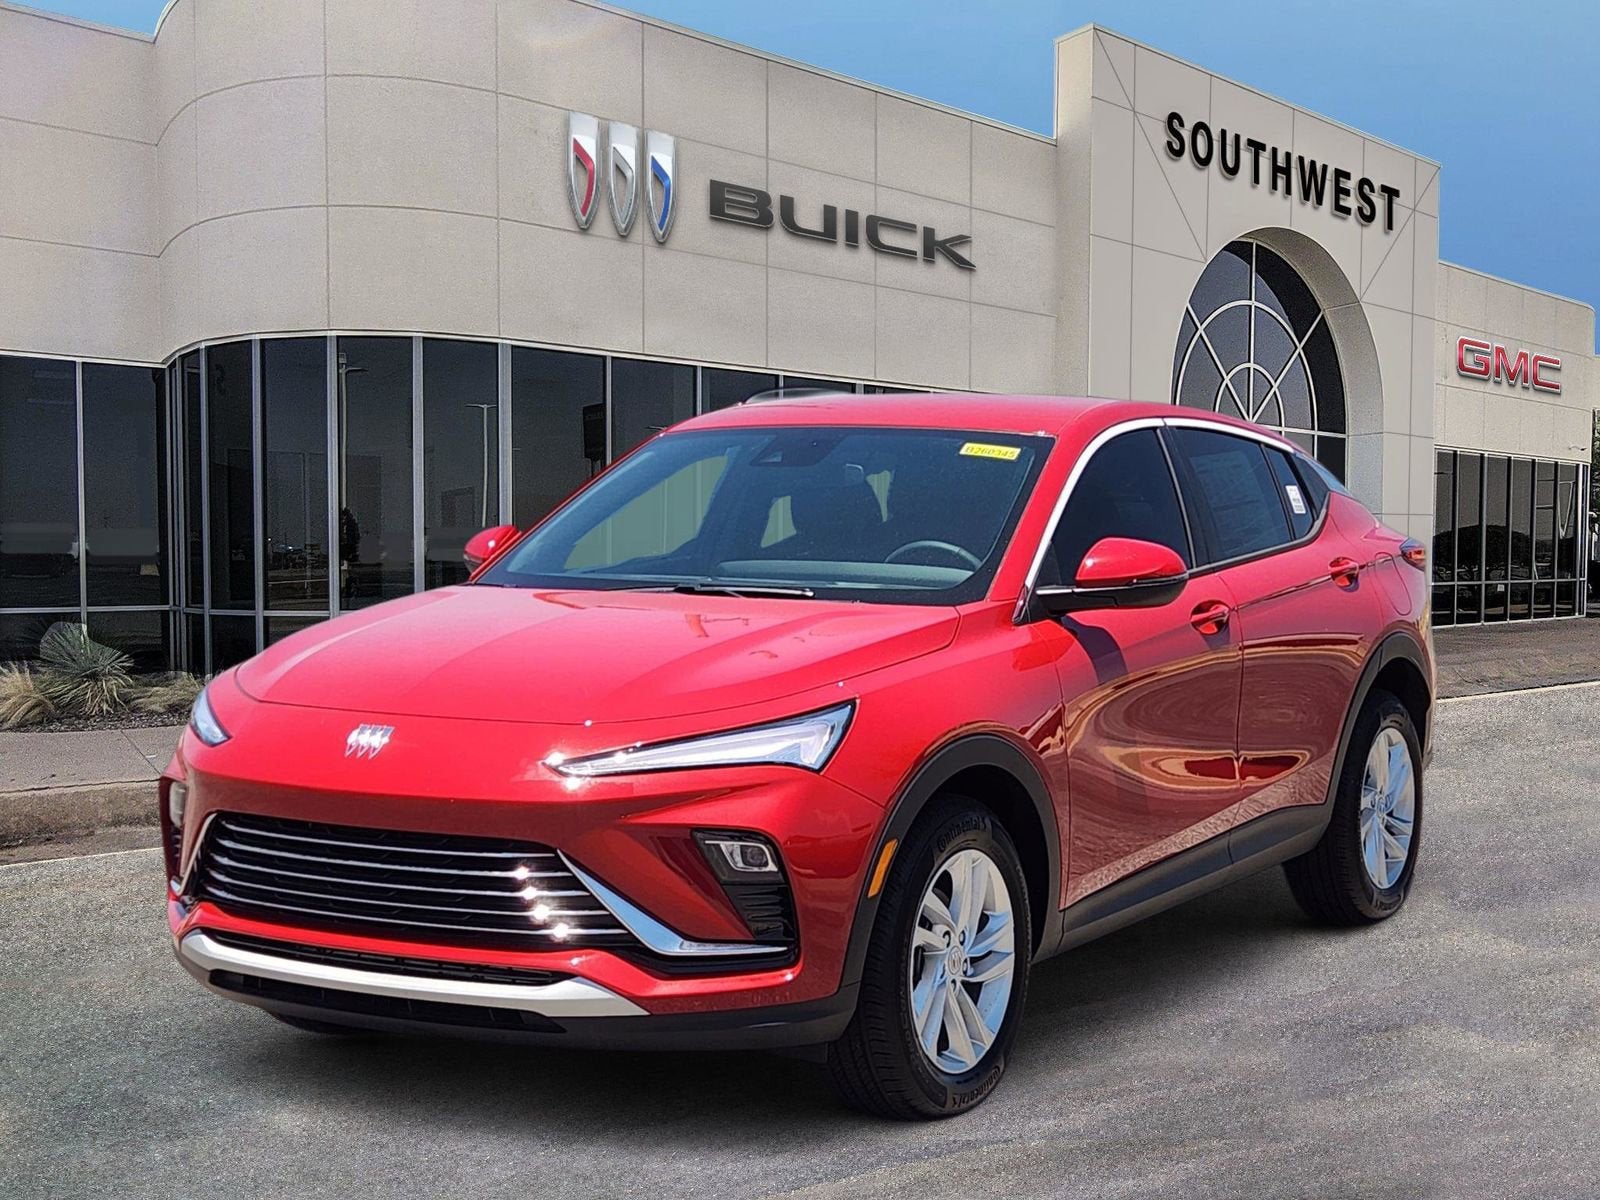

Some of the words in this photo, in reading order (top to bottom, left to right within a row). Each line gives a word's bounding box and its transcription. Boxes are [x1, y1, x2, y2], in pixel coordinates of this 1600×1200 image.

[1166, 112, 1400, 232] SOUTHWEST
[709, 179, 976, 270] BUICK
[1457, 336, 1561, 394] GMC
